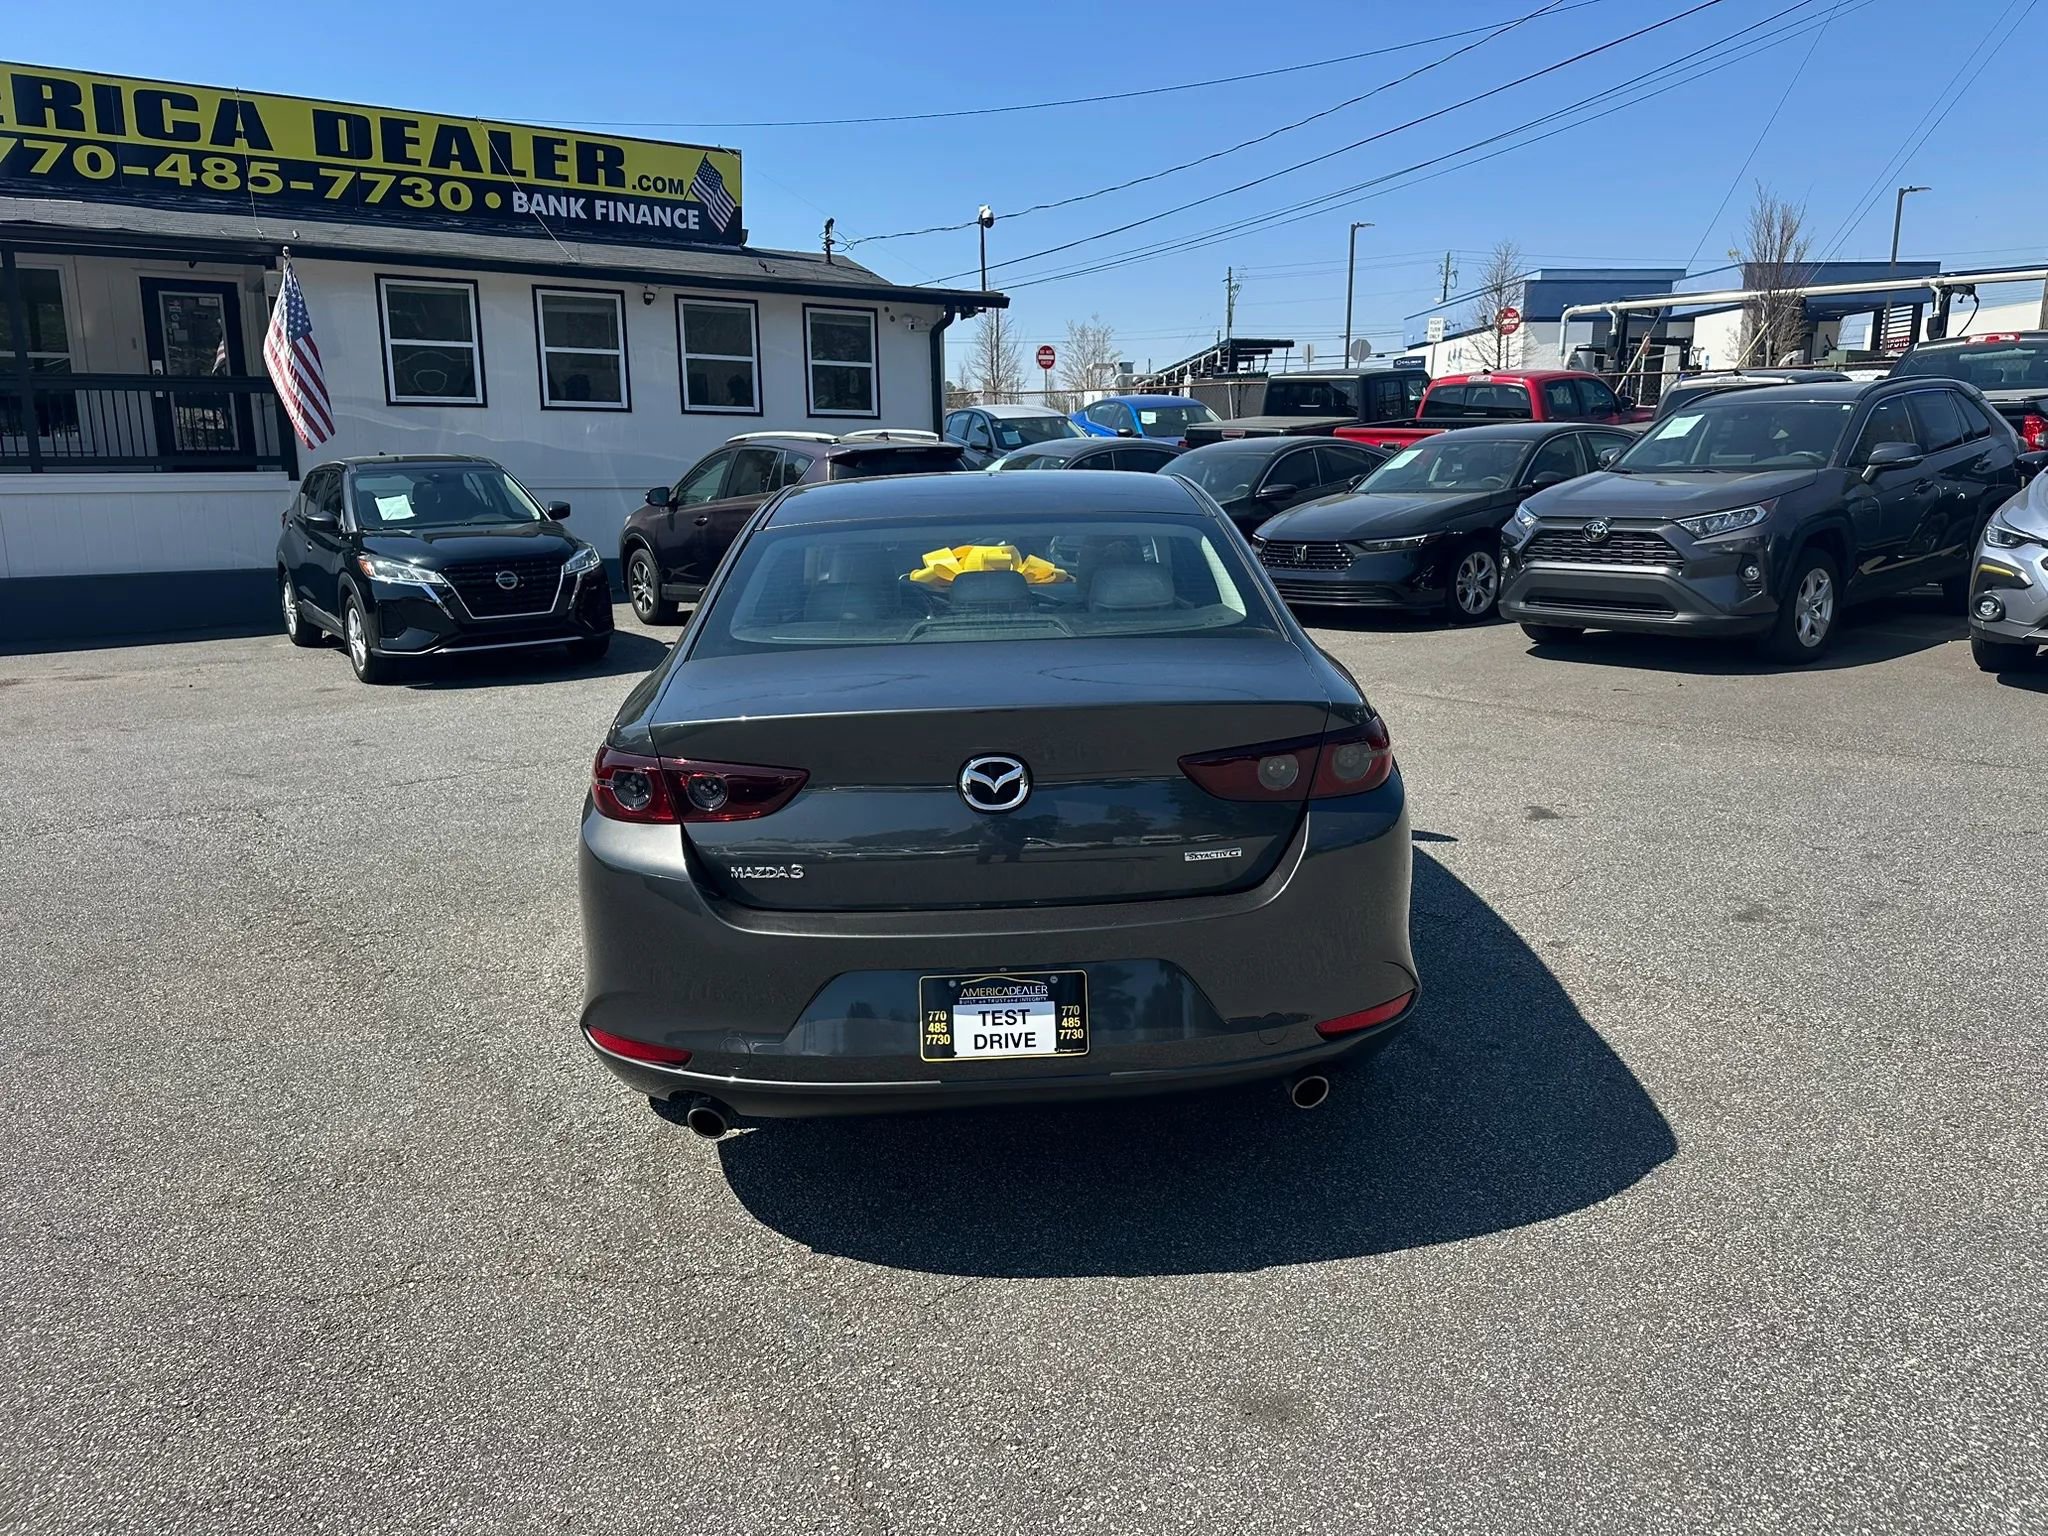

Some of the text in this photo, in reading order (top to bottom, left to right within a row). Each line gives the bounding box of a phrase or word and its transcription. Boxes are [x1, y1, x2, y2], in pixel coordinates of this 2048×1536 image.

[0, 73, 275, 152] RICA
[512, 191, 700, 231] BANK FINANCE
[928, 1010, 947, 1021] 770
[1061, 1005, 1080, 1016] 770
[977, 1008, 1031, 1026] TEST
[1061, 1017, 1081, 1028] 485
[928, 1022, 947, 1033] 485
[925, 1034, 951, 1045] 7730
[1059, 1028, 1084, 1040] 7730
[973, 1031, 1037, 1050] DRIVE
